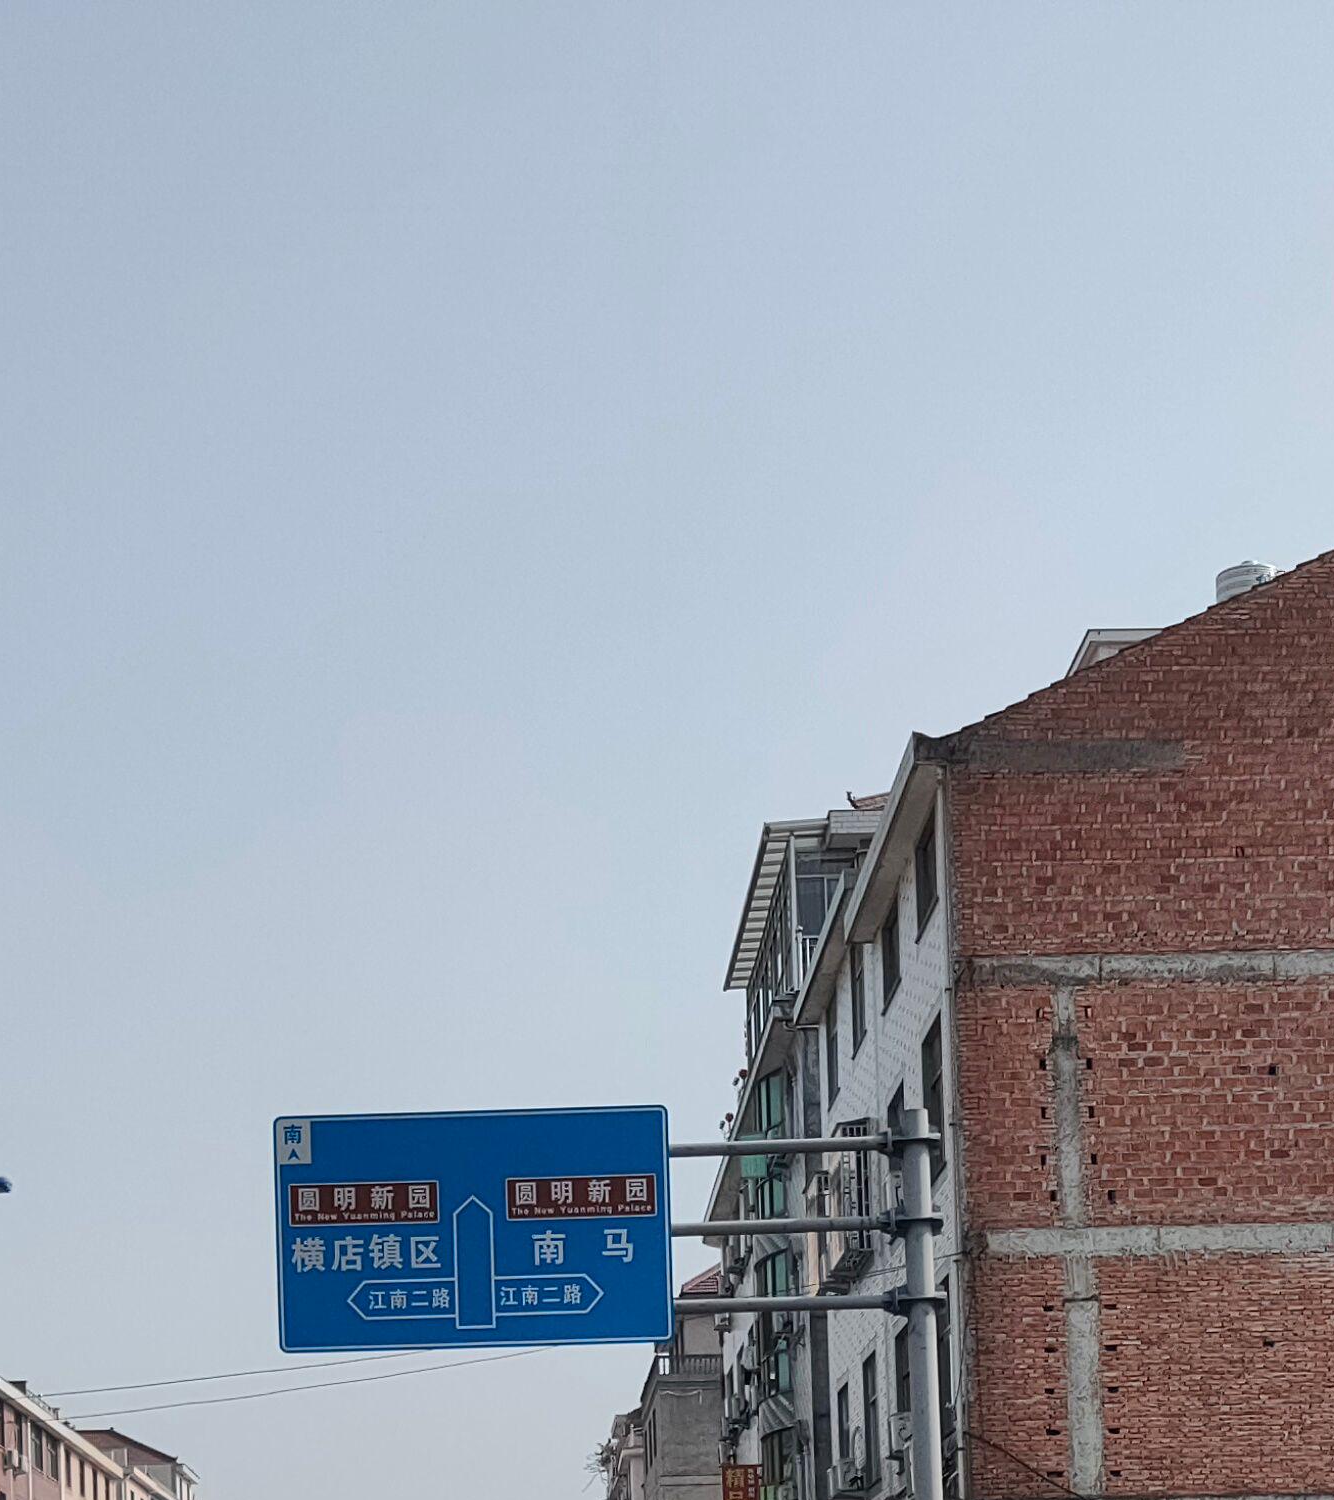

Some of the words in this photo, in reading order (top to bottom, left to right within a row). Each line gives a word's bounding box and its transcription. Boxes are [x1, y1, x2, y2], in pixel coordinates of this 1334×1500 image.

[283, 1124, 302, 1145] 南
[298, 1184, 430, 1211] 圆明新园
[515, 1178, 647, 1205] 圆明新园
[294, 1213, 312, 1222] The
[343, 1211, 395, 1221] Yuanming
[401, 1210, 435, 1219] Palace
[512, 1207, 529, 1216] The
[560, 1205, 612, 1215] Yuanming
[618, 1203, 652, 1213] Palace
[291, 1233, 441, 1273] 横店镇区
[531, 1229, 634, 1266] 南马
[369, 1287, 450, 1310] 江南二路
[500, 1283, 582, 1306] 江南二路
